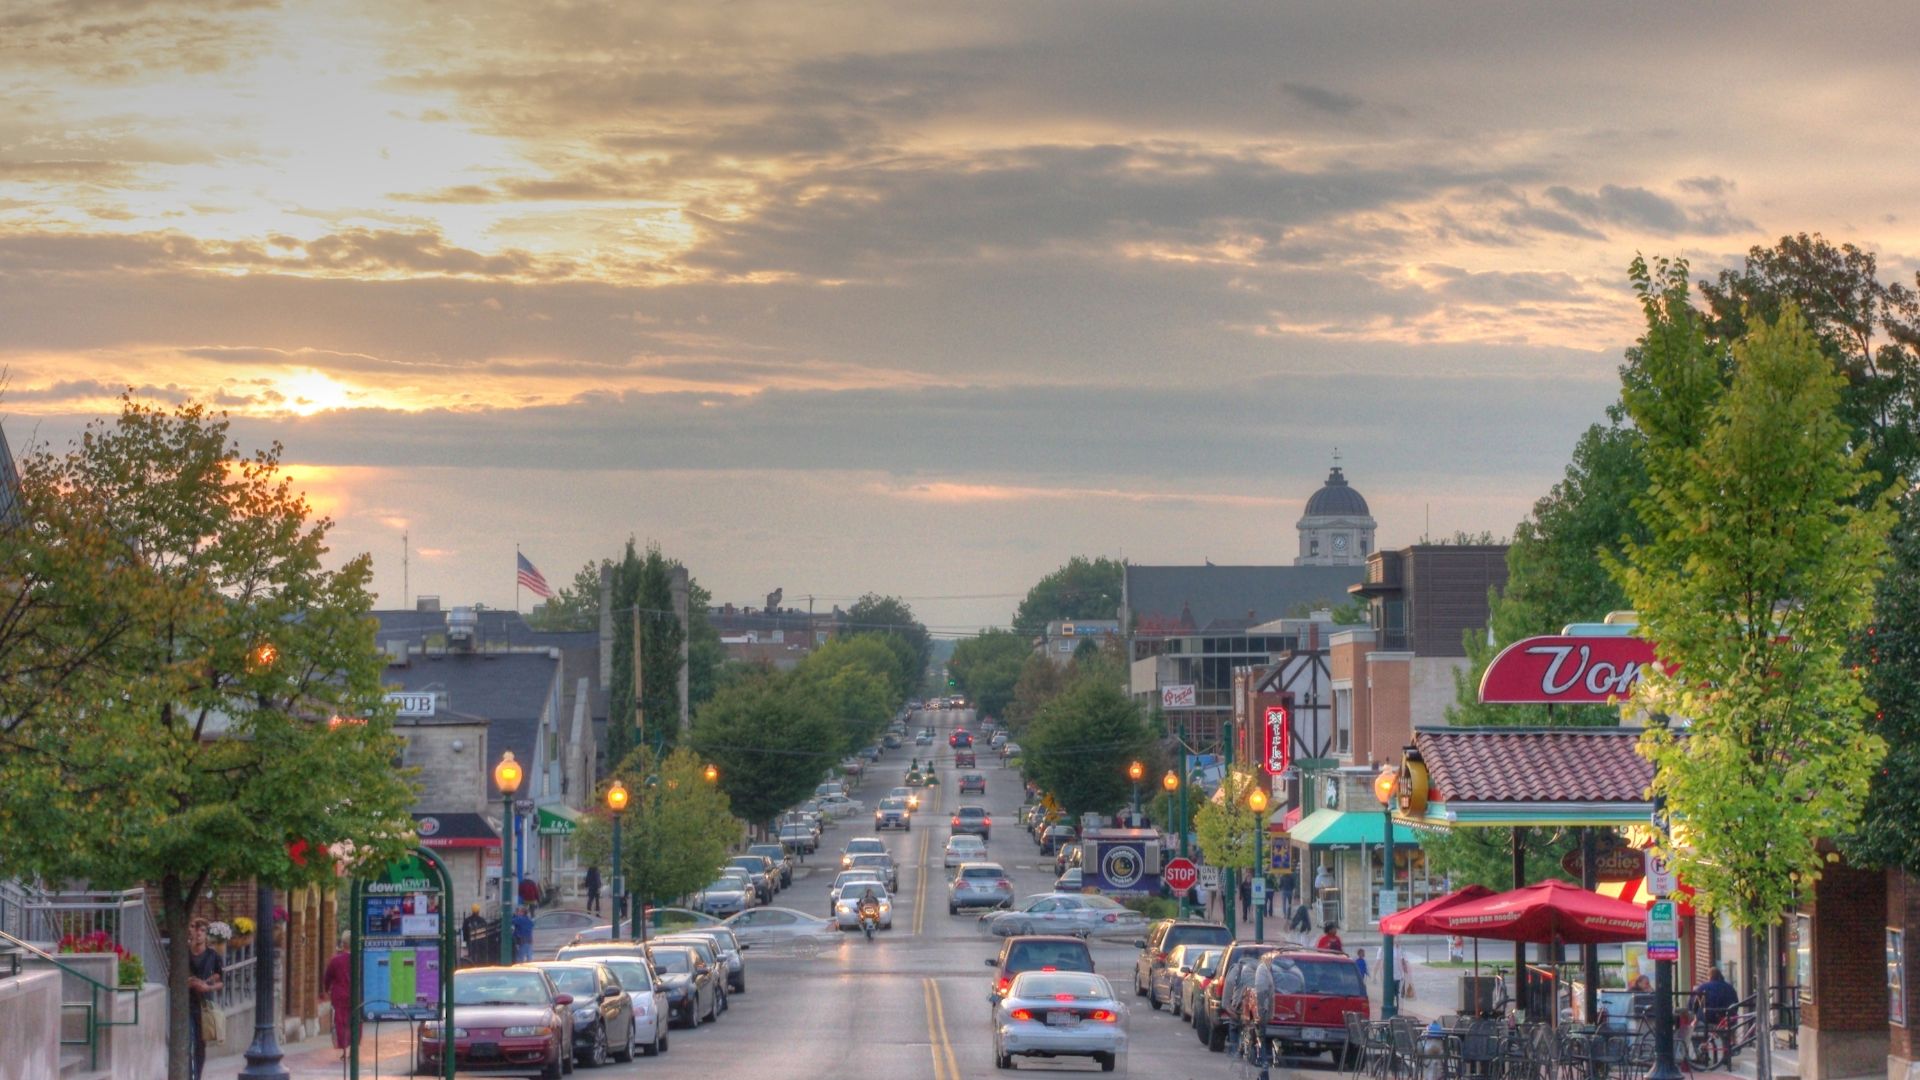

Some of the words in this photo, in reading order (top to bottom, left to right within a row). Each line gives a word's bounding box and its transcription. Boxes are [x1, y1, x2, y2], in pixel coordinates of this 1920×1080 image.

[1164, 687, 1193, 706] Pizza
[1268, 711, 1284, 771] Nick's
[1167, 868, 1195, 880] STOP
[368, 878, 430, 893] downtown
[1449, 915, 1479, 926] japanese
[1480, 914, 1493, 924] pan
